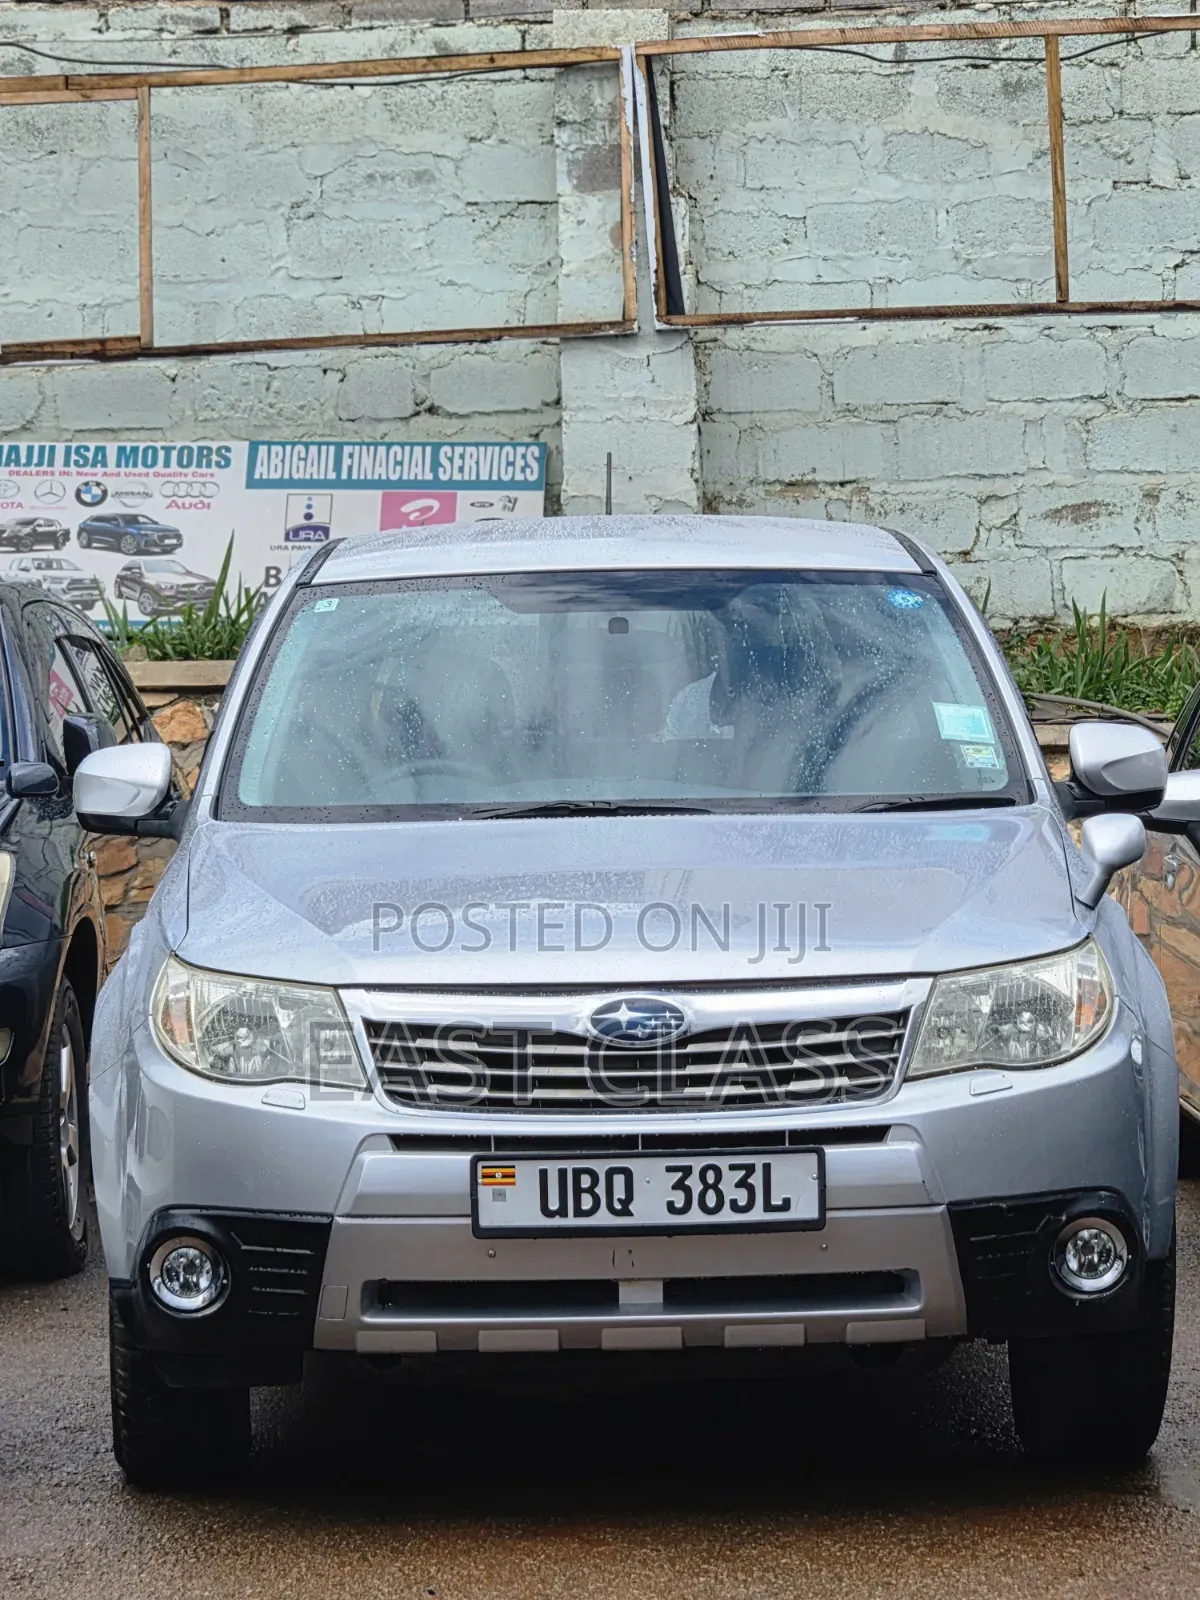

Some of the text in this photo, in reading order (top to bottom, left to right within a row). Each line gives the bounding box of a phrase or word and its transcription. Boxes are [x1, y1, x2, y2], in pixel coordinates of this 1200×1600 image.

[63, 444, 108, 469] ISA
[115, 444, 232, 469] MOTORS
[254, 444, 540, 481] ABIGAIL FINACIAL SERVICES
[102, 470, 121, 478] And
[152, 471, 189, 479] Quality
[164, 499, 212, 511] Audi
[289, 530, 326, 541] URA
[269, 544, 289, 552] URA
[538, 1161, 792, 1219] UBQ 383L
